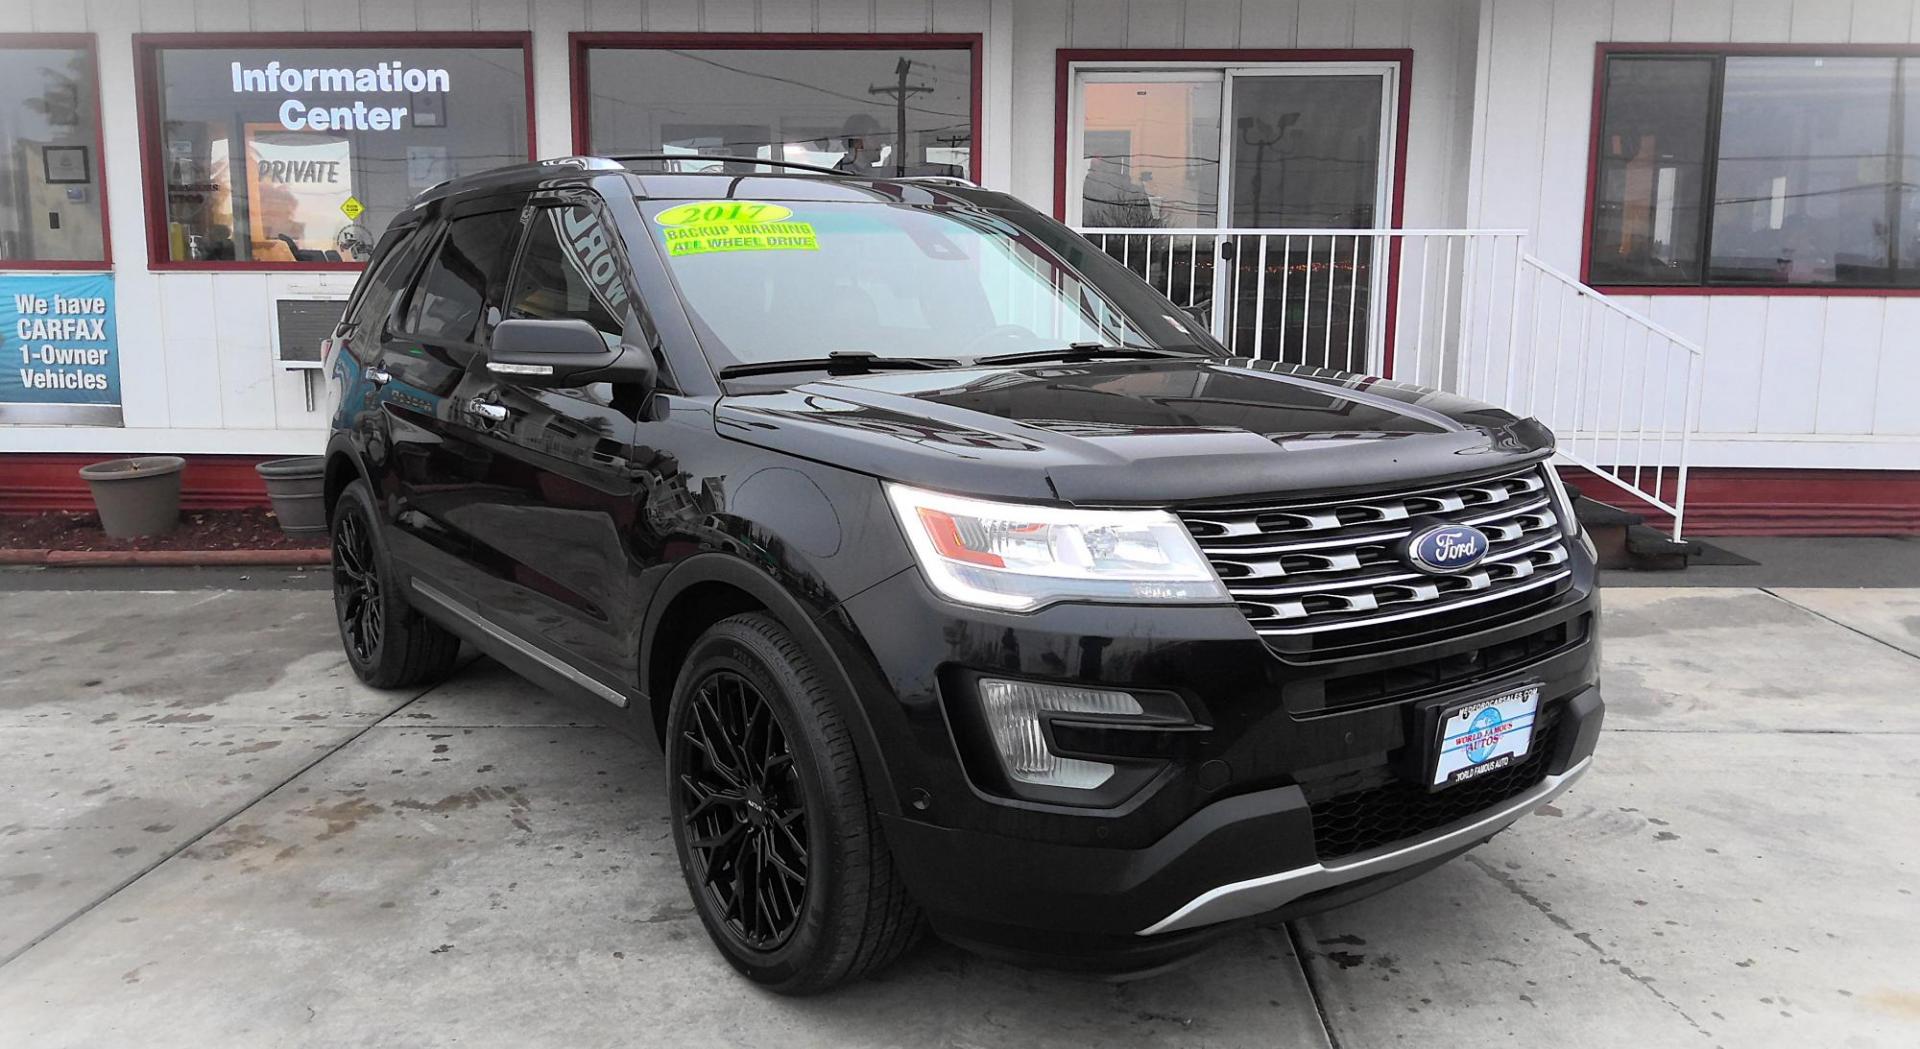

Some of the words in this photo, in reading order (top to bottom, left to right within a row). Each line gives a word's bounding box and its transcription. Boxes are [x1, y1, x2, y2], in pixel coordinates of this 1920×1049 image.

[231, 61, 450, 93] Information
[279, 99, 407, 131] Center
[258, 160, 341, 184] PRIVATE
[680, 205, 769, 224] 2017
[666, 225, 730, 240] BACKUP
[734, 223, 811, 235] WARNING
[673, 240, 704, 251] ALL
[708, 237, 762, 248] WHEEL
[766, 236, 813, 247] DRIVE
[14, 293, 48, 315] We
[54, 294, 105, 315] have
[17, 318, 106, 341] CARFAX
[19, 344, 108, 365] 1-Owner
[20, 368, 108, 390] Vehicles
[1436, 532, 1477, 561] Ford
[1455, 731, 1482, 746] WORLD
[1484, 723, 1513, 738] FAMOUS
[1466, 734, 1499, 751] AUTOS
